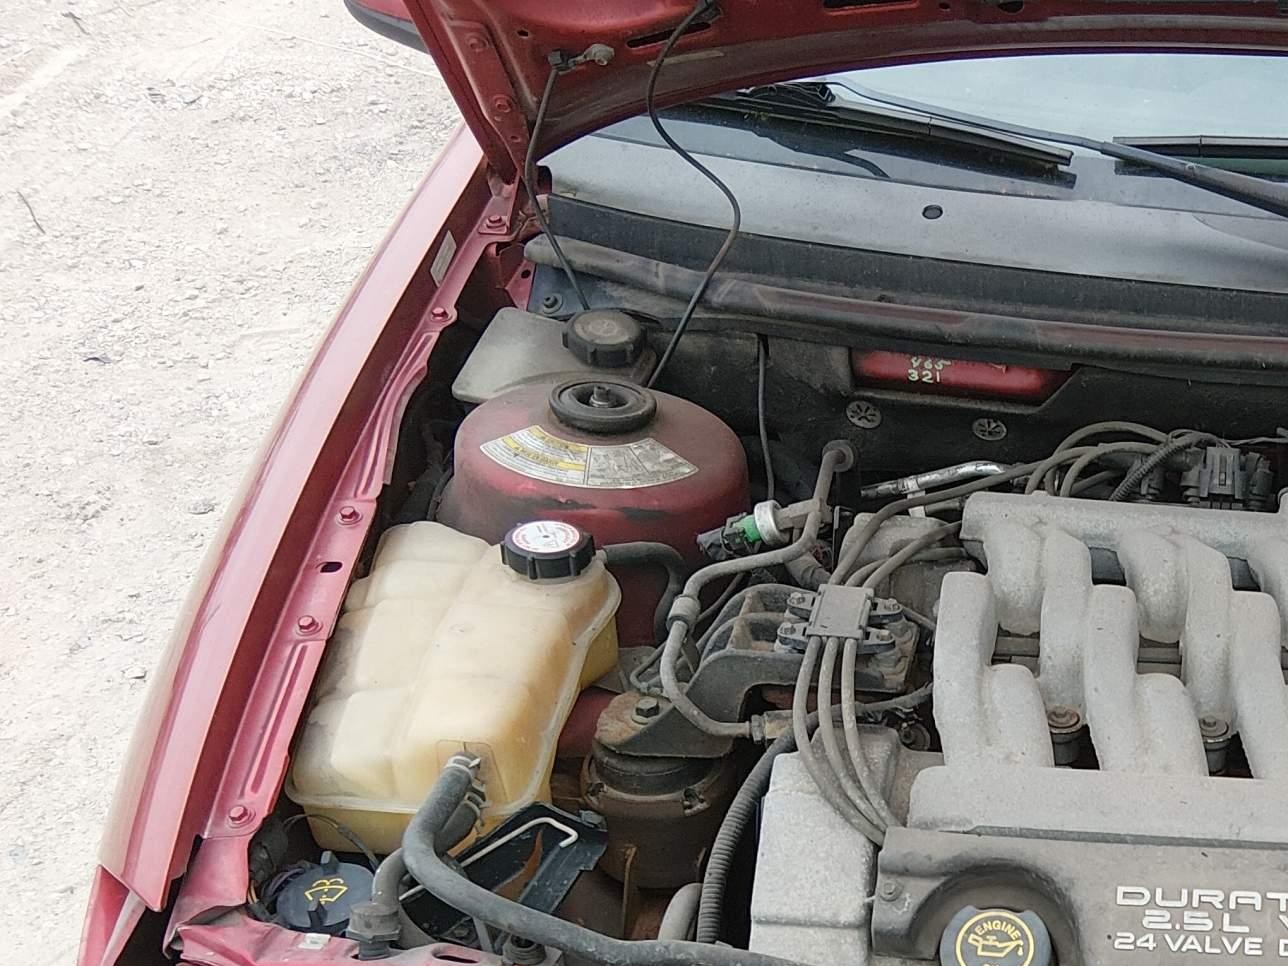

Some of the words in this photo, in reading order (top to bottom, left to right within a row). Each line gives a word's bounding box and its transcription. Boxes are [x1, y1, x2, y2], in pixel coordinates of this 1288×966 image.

[908, 369, 941, 384] 321
[974, 920, 1022, 941] ENGINE
[1114, 932, 1157, 951] 24
[1162, 934, 1263, 956] VALVE
